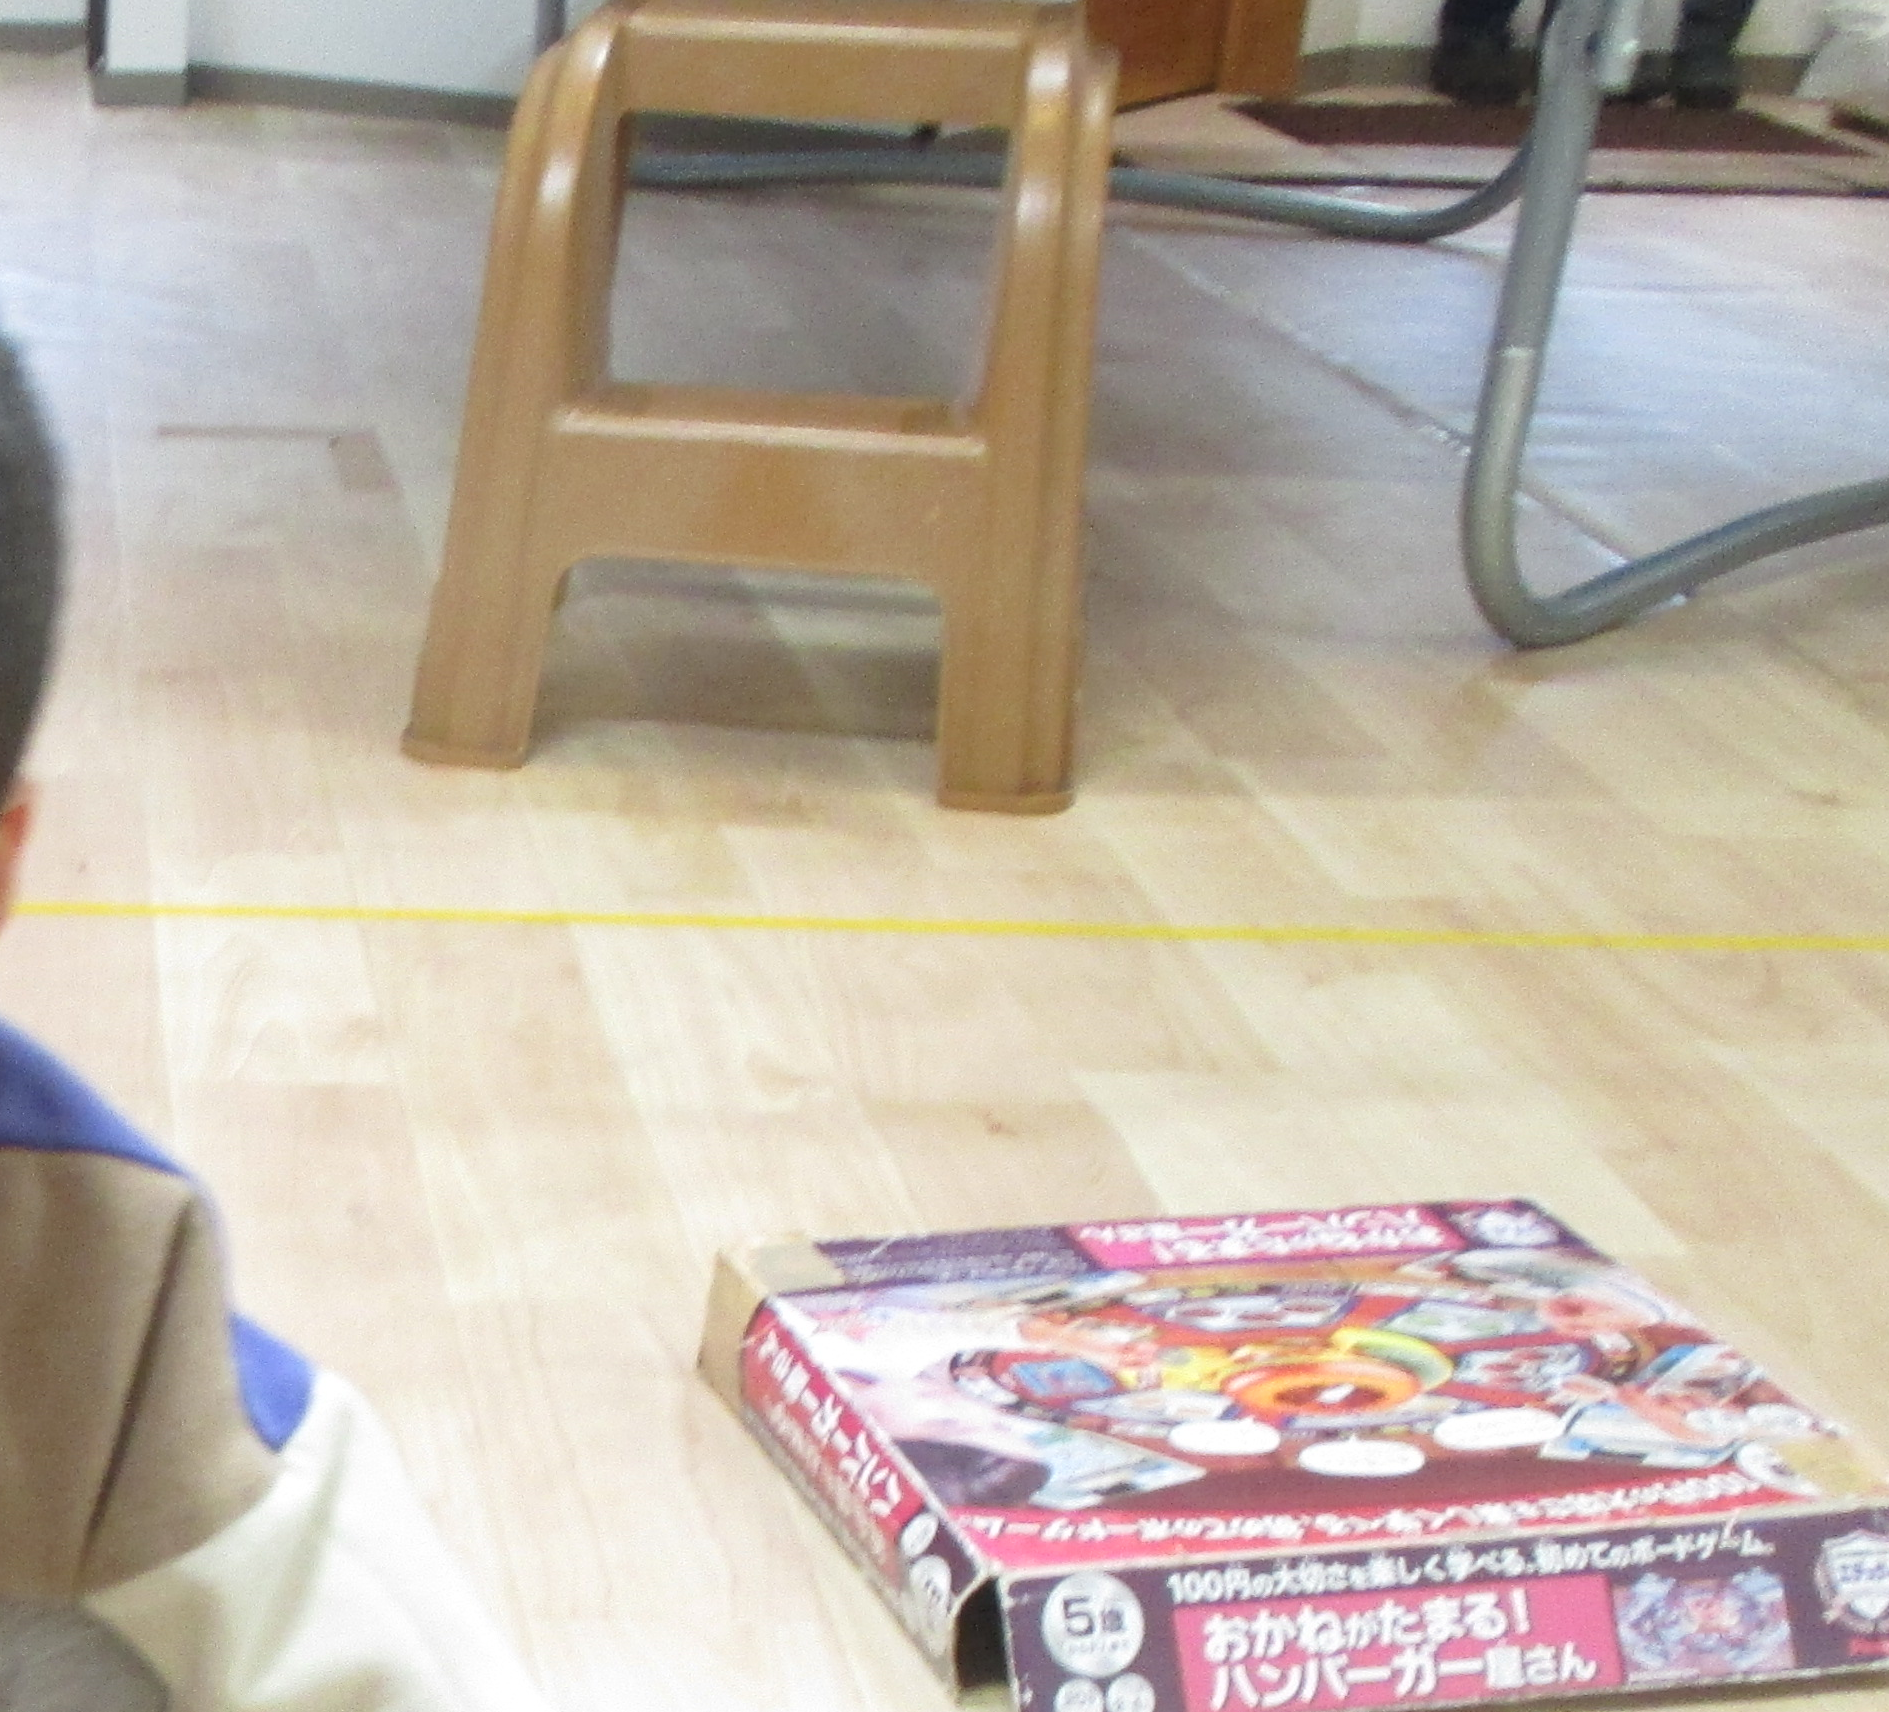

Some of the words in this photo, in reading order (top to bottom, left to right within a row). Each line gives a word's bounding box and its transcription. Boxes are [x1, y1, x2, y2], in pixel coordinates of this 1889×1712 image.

[1210, 1640, 1597, 1712] ハンバーガー屋さん
